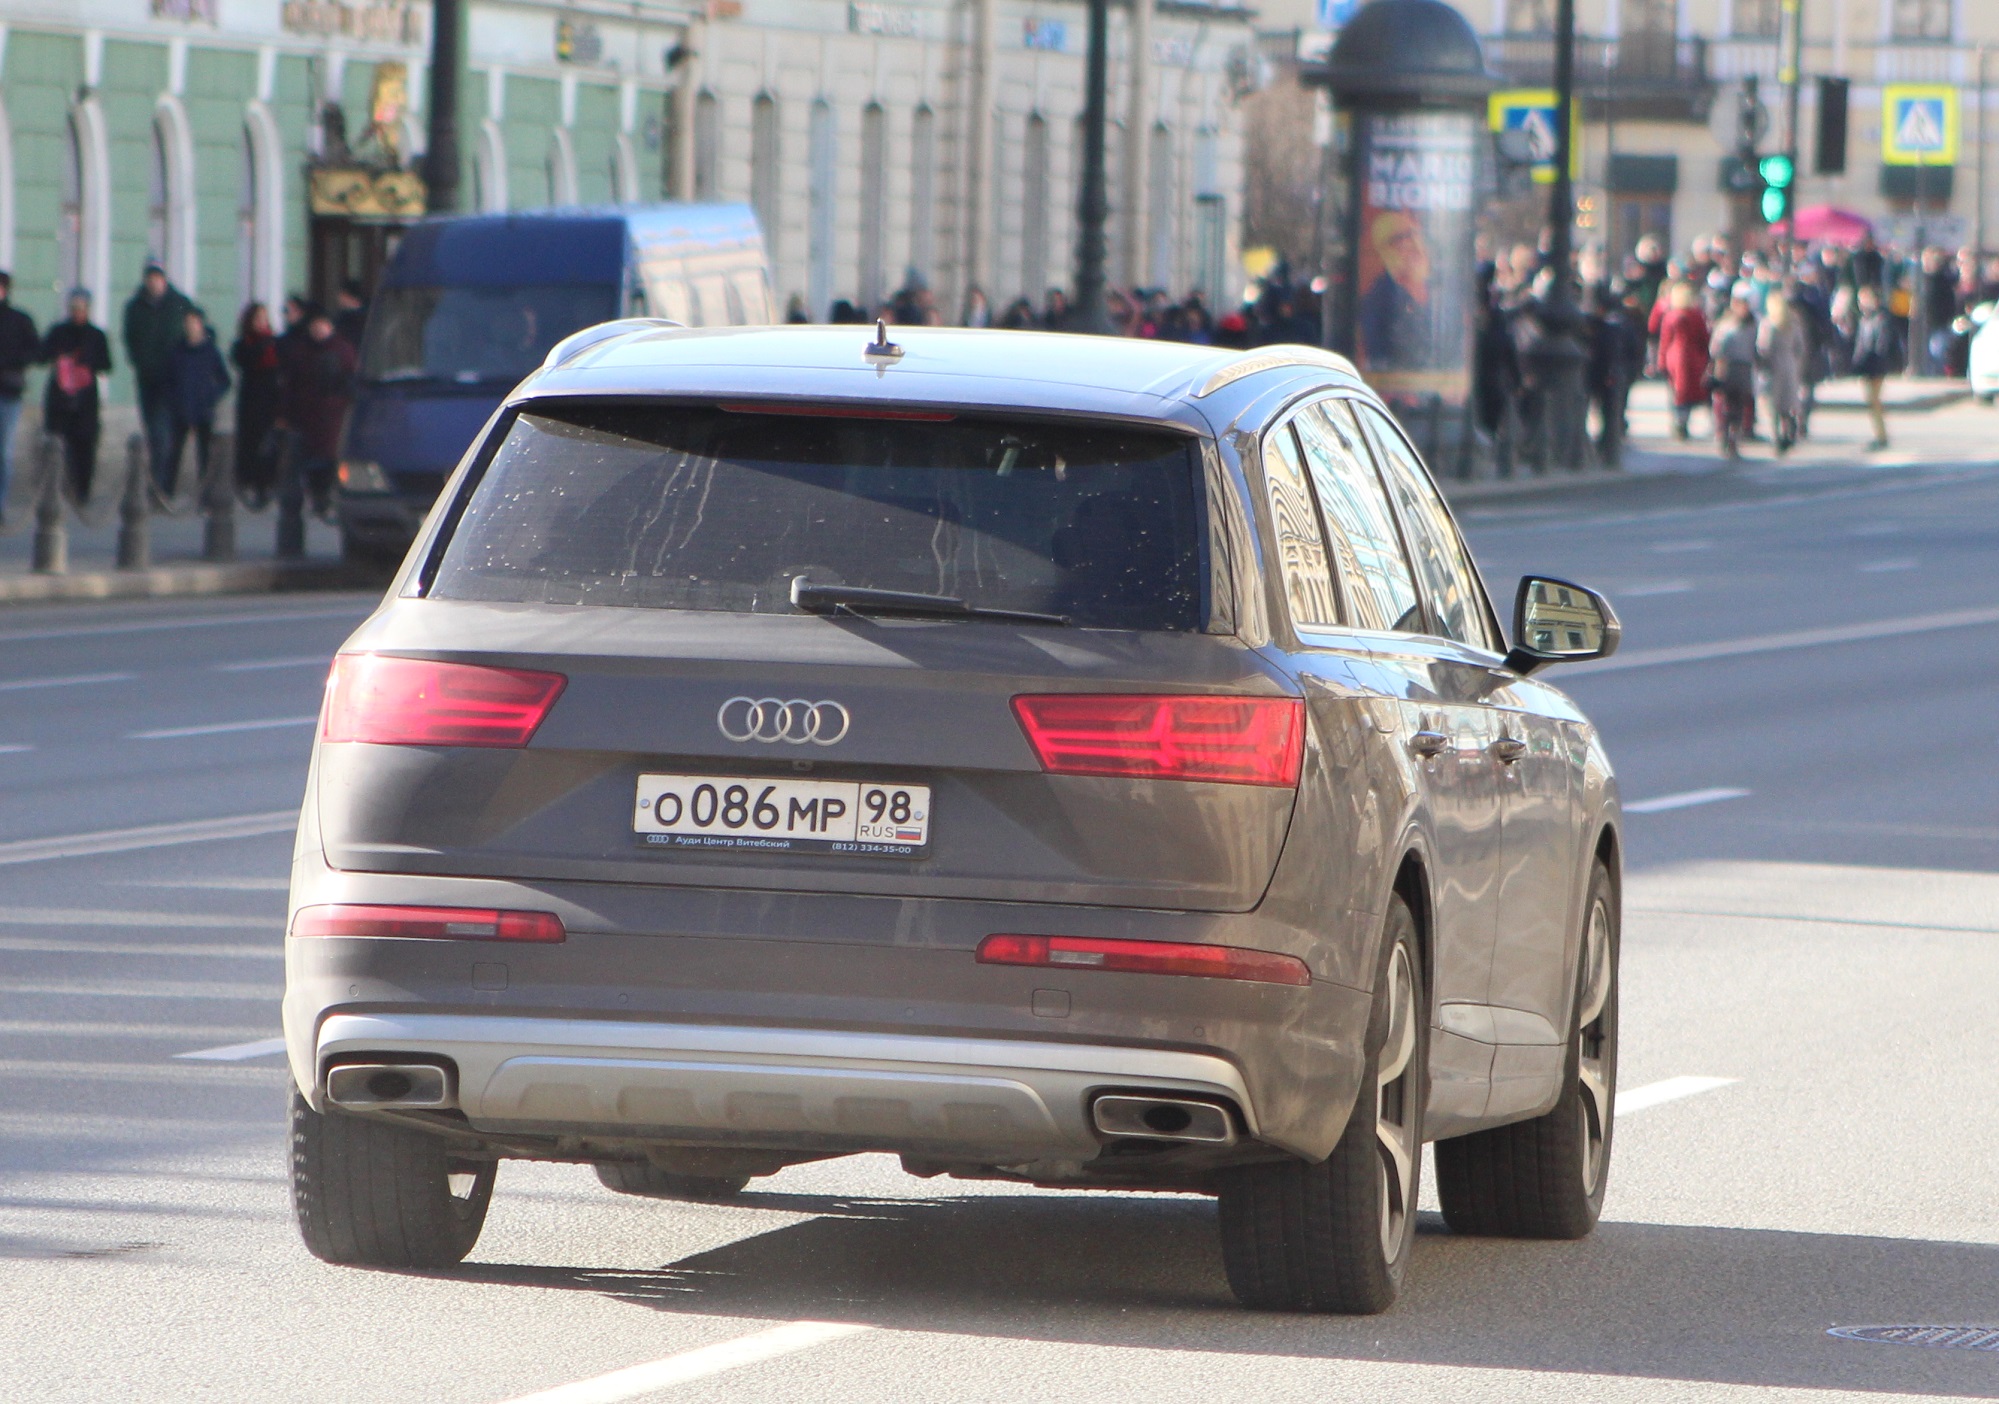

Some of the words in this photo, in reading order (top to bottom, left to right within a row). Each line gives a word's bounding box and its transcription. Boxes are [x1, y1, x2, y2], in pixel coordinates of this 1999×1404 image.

[865, 789, 911, 824] 98
[860, 825, 894, 838] RUS
[675, 836, 701, 845] Ауди
[703, 837, 734, 846] Центр
[736, 838, 790, 848] Витебский
[832, 842, 858, 852] (812)
[860, 844, 911, 854] 334-35-00
